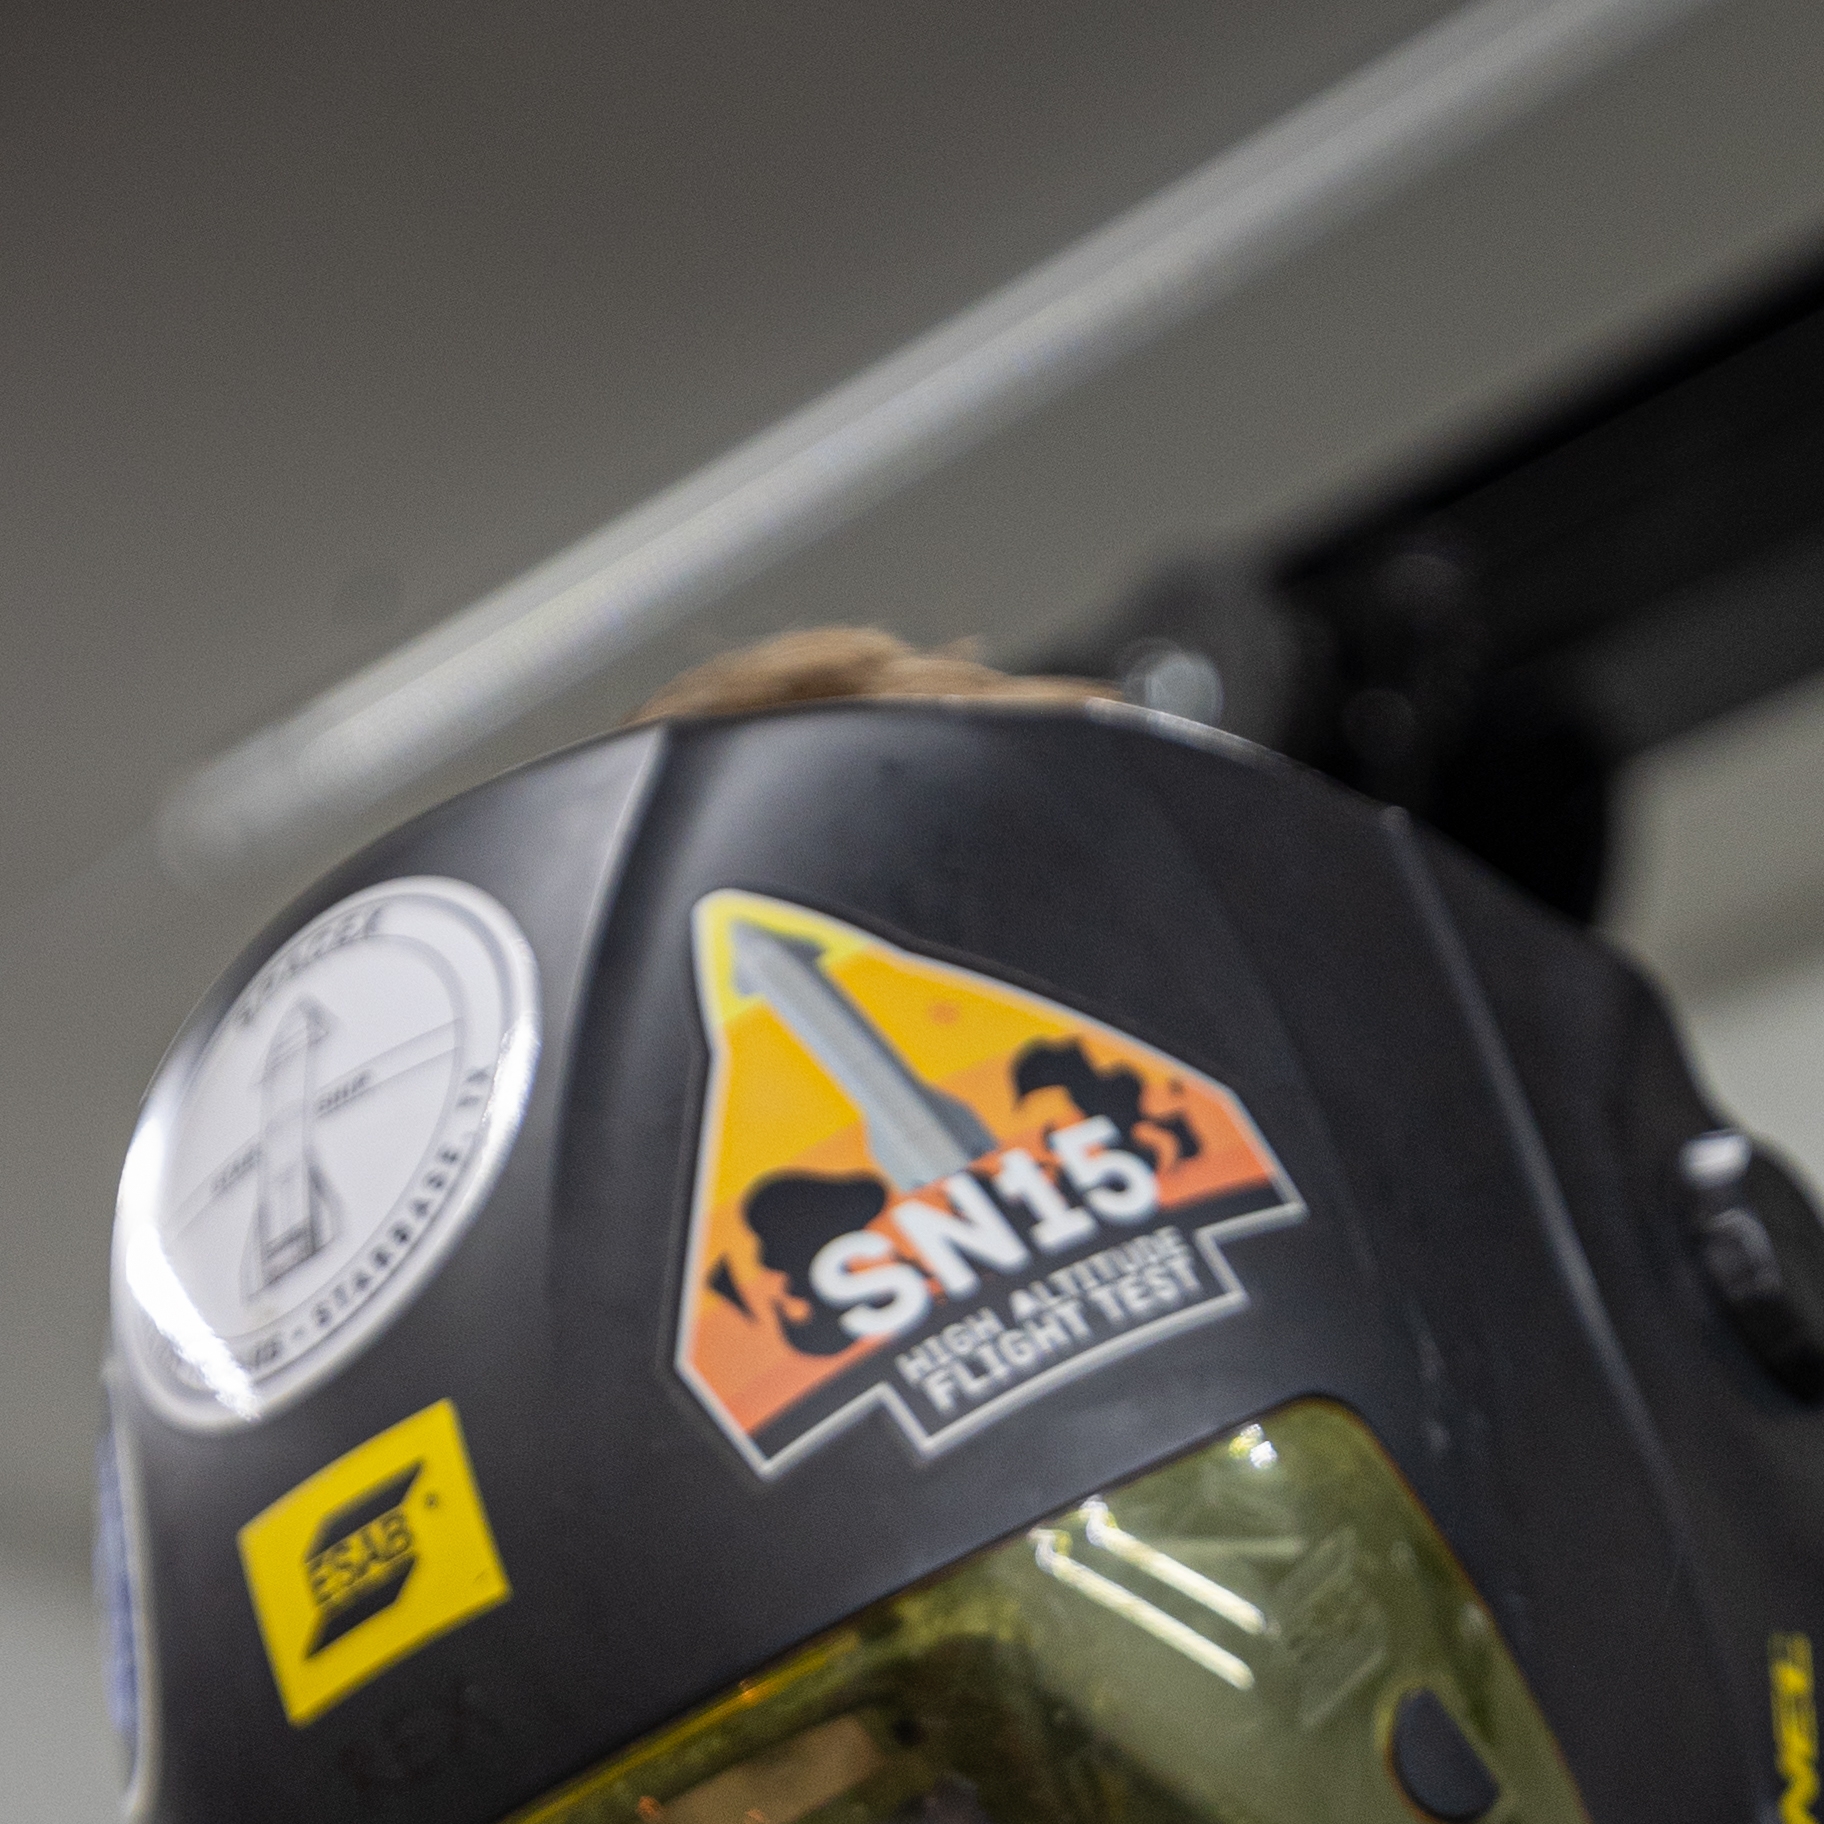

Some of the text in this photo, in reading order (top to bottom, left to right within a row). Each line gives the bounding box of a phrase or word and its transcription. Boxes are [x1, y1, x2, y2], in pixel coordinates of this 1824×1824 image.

[808, 1113, 1158, 1341] SN15
[895, 1224, 1186, 1387] HIGH ALTITUDE
[922, 1254, 1203, 1414] FLIGHT TEST
[306, 1507, 413, 1604] ESAB
